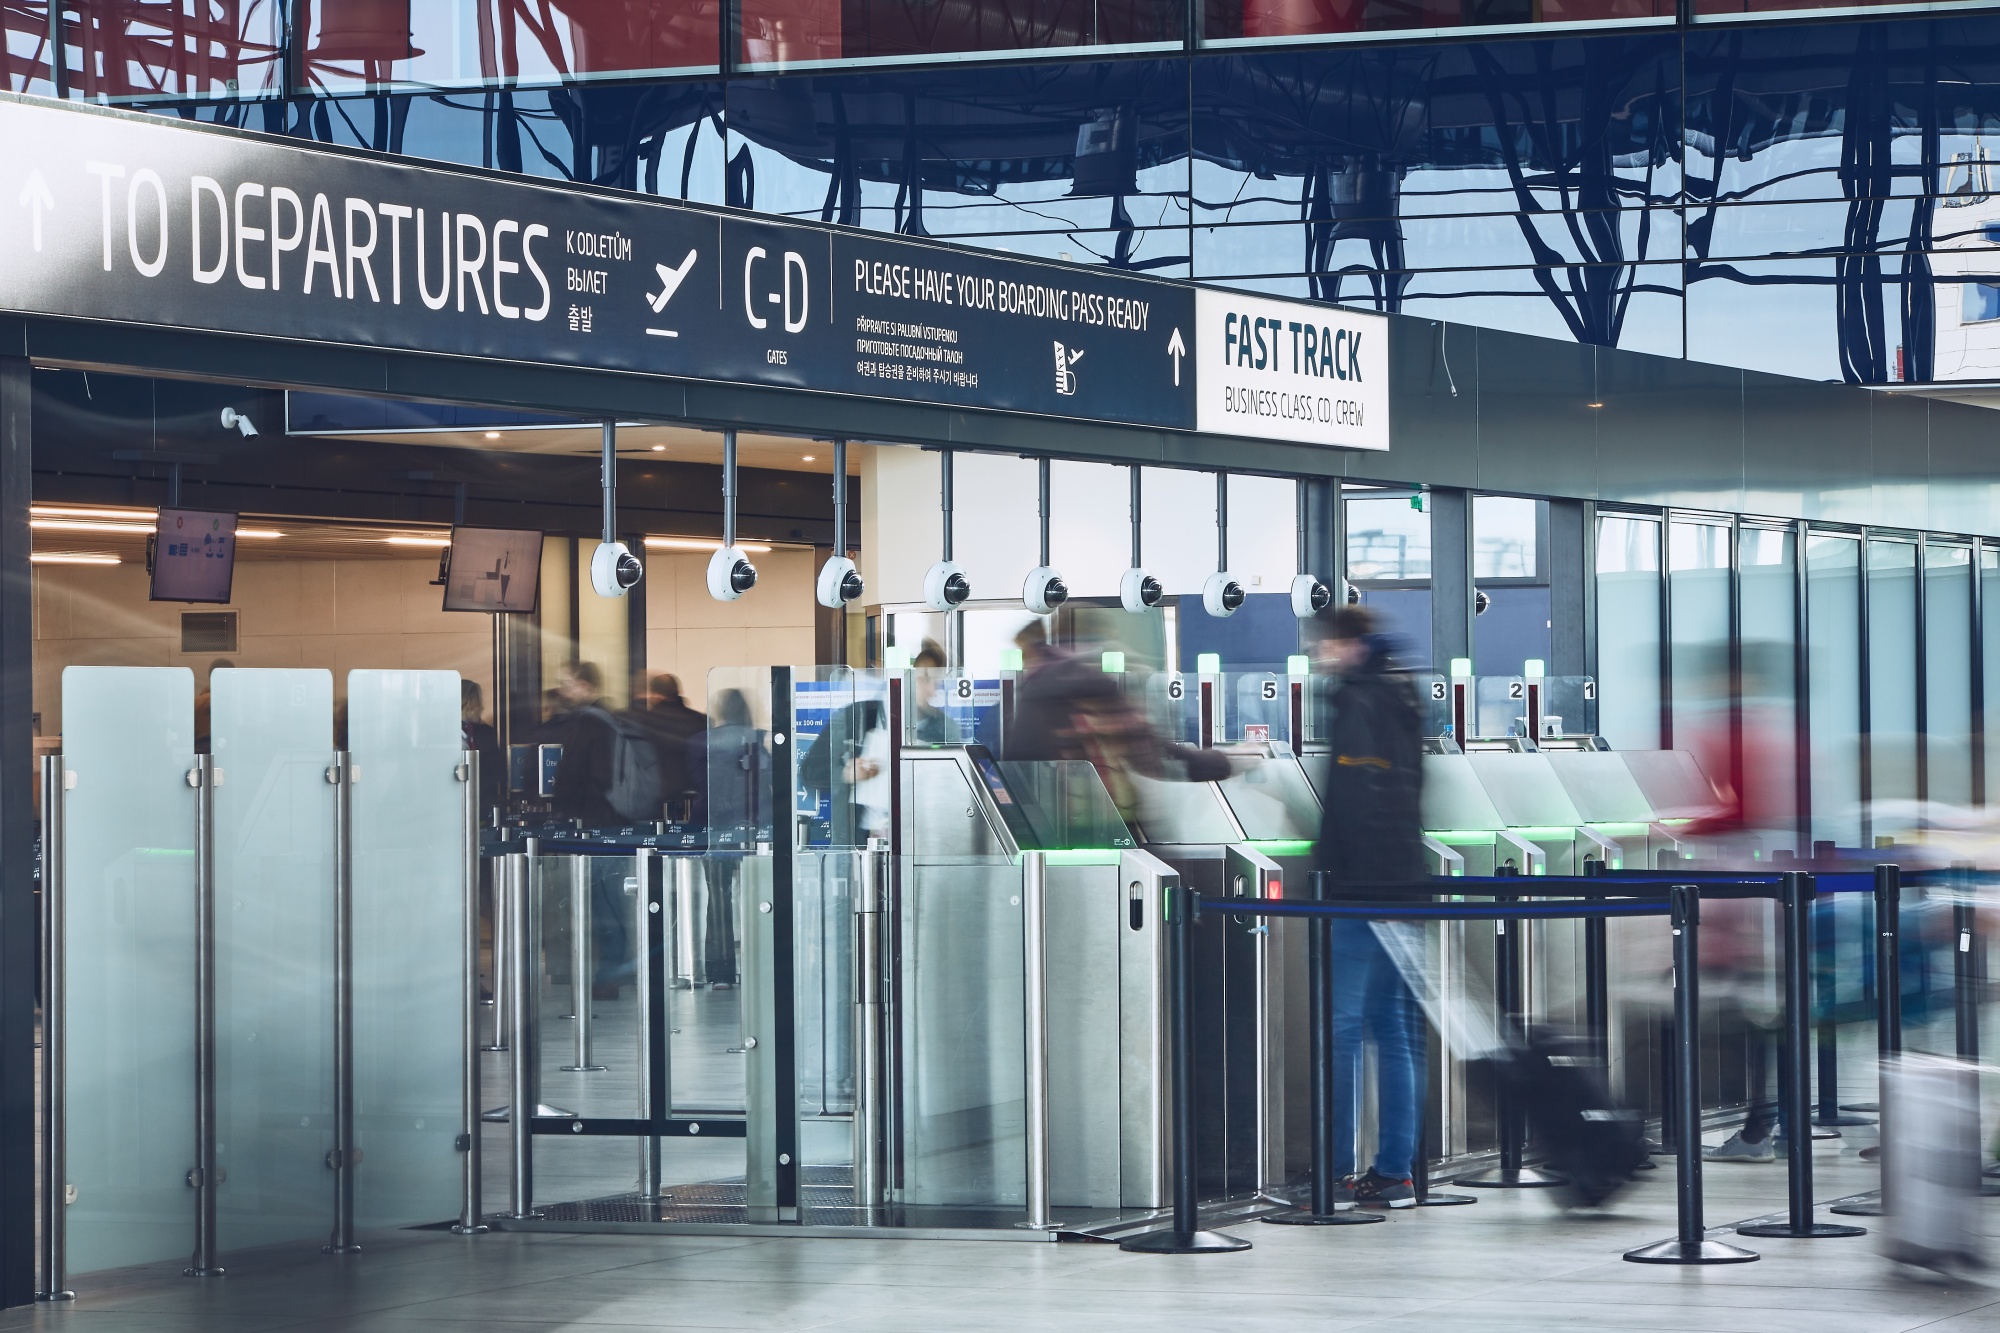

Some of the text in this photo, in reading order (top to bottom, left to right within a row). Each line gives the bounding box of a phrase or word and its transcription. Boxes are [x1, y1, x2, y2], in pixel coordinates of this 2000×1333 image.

[86, 160, 551, 321] TO DEPARTURES
[566, 230, 632, 261] K ODLETŮM
[567, 267, 608, 295] ВЫЛЕТ
[744, 246, 809, 334] C-D
[855, 259, 1149, 332] PLEASE HAVE YOUR BOARDING PASS READY
[567, 304, 593, 333] 출발
[856, 315, 958, 344] PŘIPRAVTE SI PALUBNÍ VSTUPENKU
[767, 349, 788, 365] GATES
[856, 339, 963, 365] ПРИГОТОВЬТЕ ПОСАДОЧНЫЙ ТАЛОН
[1225, 312, 1363, 383] FAST TRACK
[856, 360, 978, 388] 여권과 탑승권을 준비하여 주시기 바랍니다
[1225, 385, 1364, 427] BUSINESS CLASS, CD, CREW
[957, 679, 972, 698] 8
[1168, 680, 1183, 699] 6
[1262, 682, 1277, 699] 5
[1432, 682, 1446, 699] 3
[1511, 682, 1523, 699] 2
[1585, 682, 1596, 699] 1
